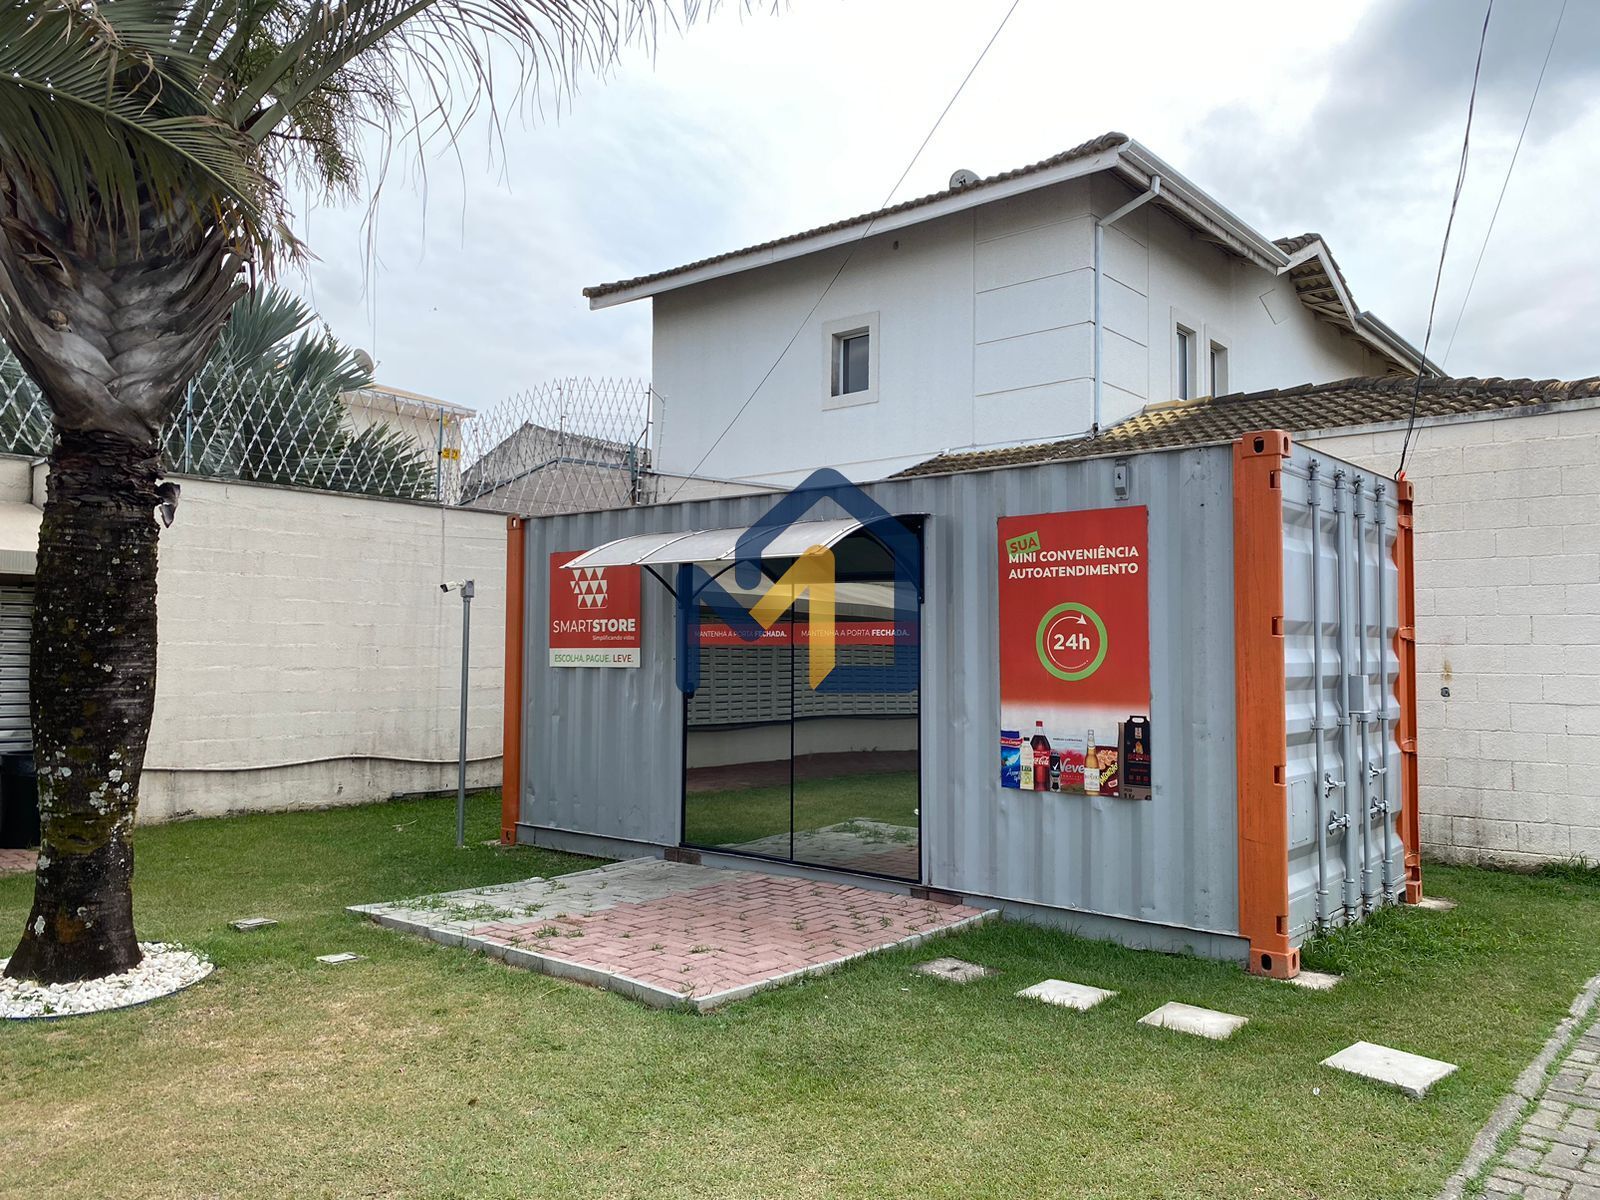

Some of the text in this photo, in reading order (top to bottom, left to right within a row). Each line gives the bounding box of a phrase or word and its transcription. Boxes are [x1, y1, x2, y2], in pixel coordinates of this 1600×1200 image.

[1009, 536, 1038, 553] SUA
[1009, 545, 1139, 563] MINI CONVENIÊNCIA
[1008, 562, 1139, 579] AUTOATENDIMENTO
[553, 618, 636, 633] SMARTSTORE
[801, 629, 910, 637] MANTENHA A PORTA FECHADA.
[1053, 633, 1091, 650] 24h
[612, 654, 634, 663] LEVE.
